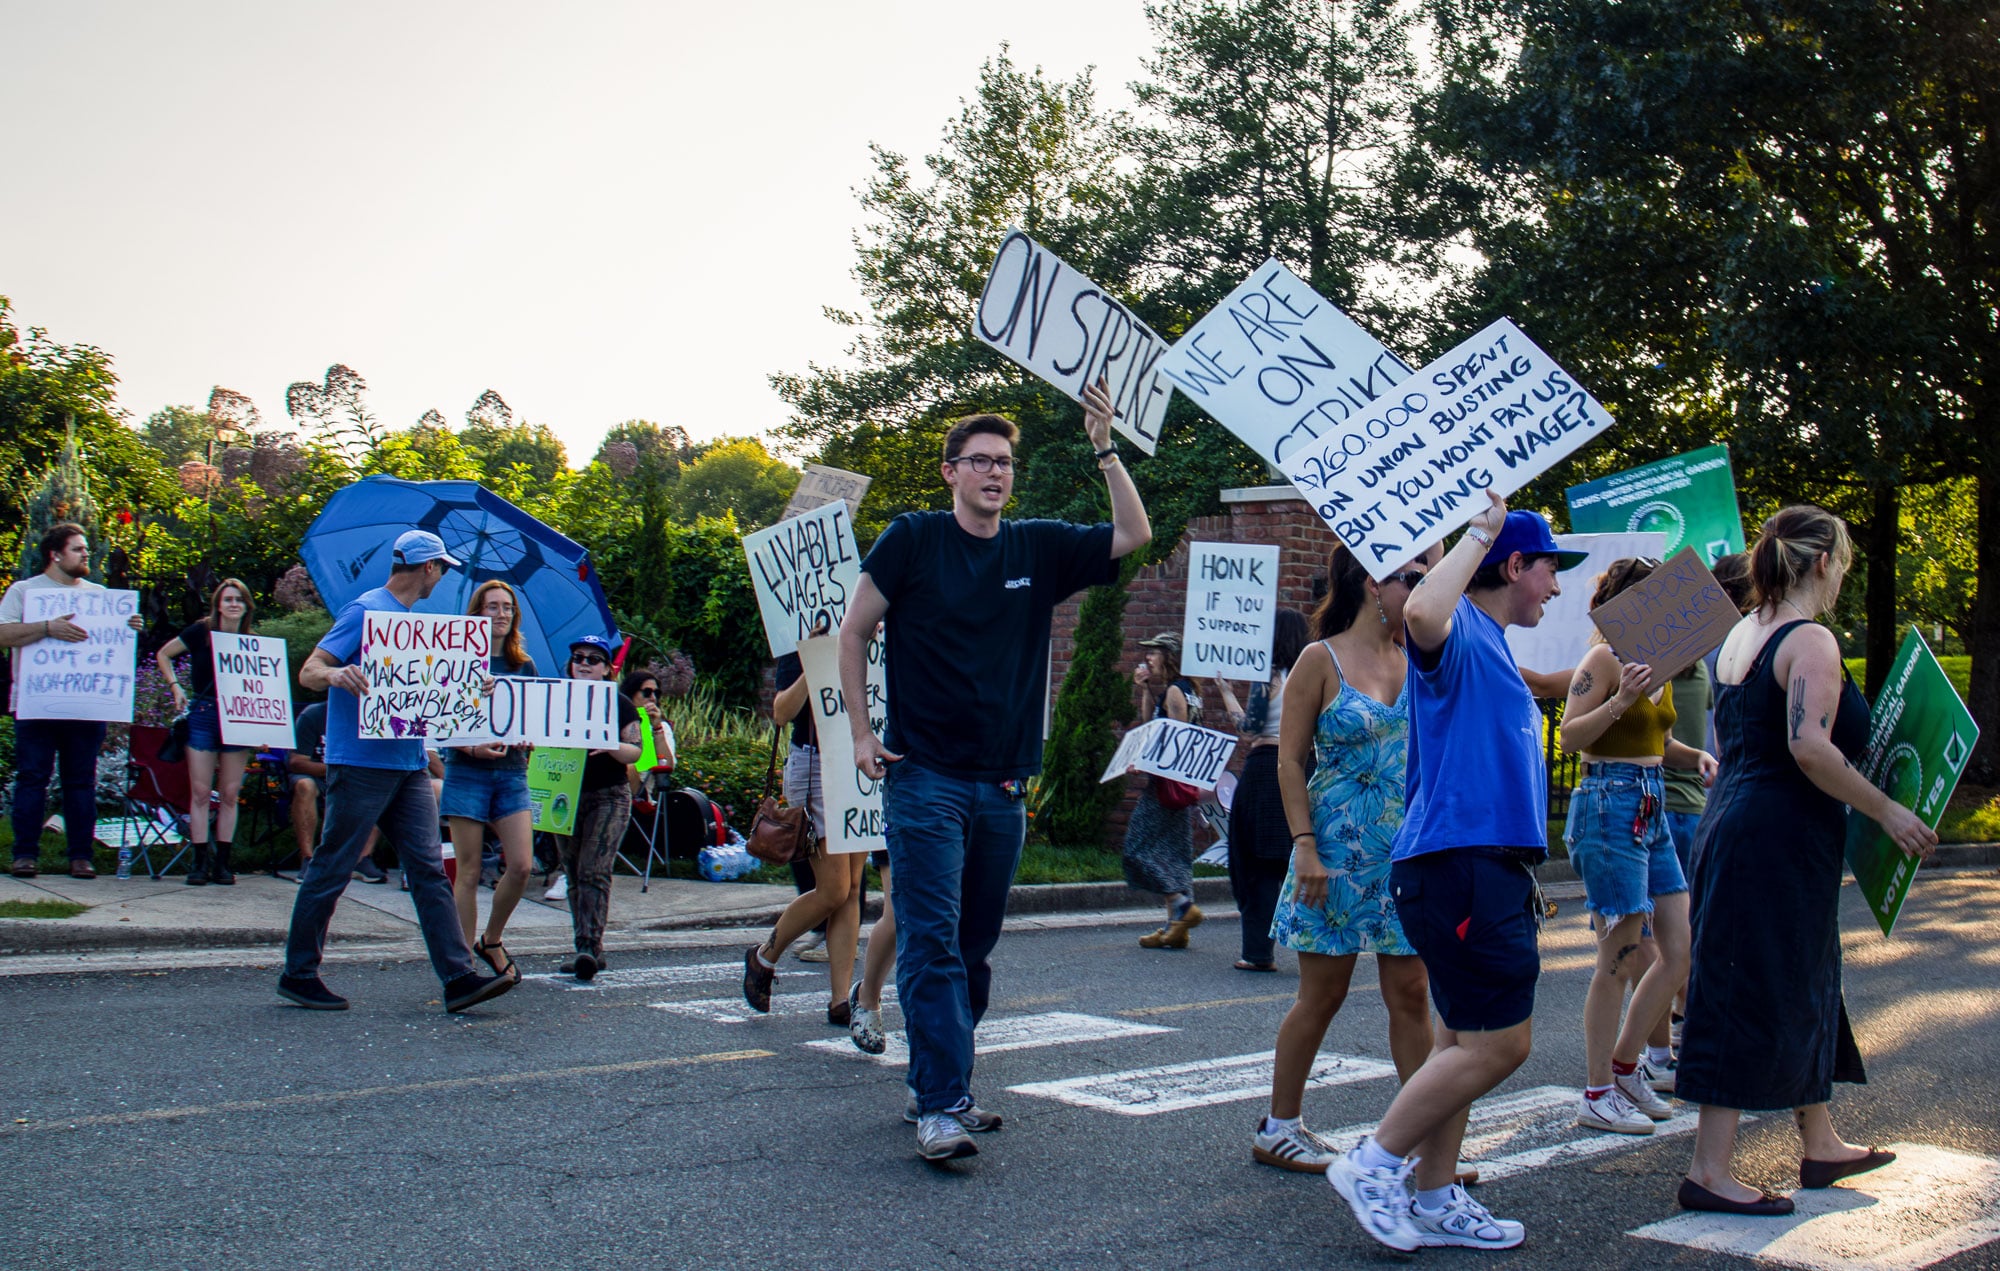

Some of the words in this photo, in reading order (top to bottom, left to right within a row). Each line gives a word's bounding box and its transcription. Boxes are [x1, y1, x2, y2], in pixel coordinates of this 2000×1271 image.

[978, 231, 1061, 361] ON
[1052, 289, 1168, 442] STRIKE
[1163, 331, 1246, 397] WE
[1228, 270, 1319, 356] ARE
[1257, 334, 1336, 406] ON
[1292, 392, 1428, 491] $260,000
[1432, 333, 1508, 396] SPENT
[1318, 490, 1354, 520] ON
[1357, 432, 1427, 489] UNION
[1429, 355, 1532, 435] BUSTING
[1335, 501, 1388, 548] BUT
[1386, 469, 1434, 506] YOU
[1428, 421, 1495, 474] WON'T
[1489, 392, 1535, 429] PAY
[1531, 370, 1571, 403] US
[1369, 542, 1402, 563] A
[1399, 467, 1494, 542] LIVING
[1494, 391, 1595, 469] WAGE?
[1571, 493, 1601, 509] LEWIS
[1684, 457, 1727, 476] GARDEN
[754, 510, 852, 592] LIVABLE
[1201, 554, 1264, 586] HONK
[33, 592, 133, 616] TAKING
[774, 566, 846, 618] WAGES
[1206, 592, 1221, 611] IF
[1235, 596, 1264, 613] YOU
[1603, 559, 1698, 639] SUPPORT
[368, 617, 489, 657] WORKERS
[798, 601, 847, 641] NOW
[1197, 617, 1260, 635] SUPPORT
[1623, 584, 1724, 665] WORKERS
[33, 648, 80, 668] OUT
[218, 652, 281, 677] MONEY
[239, 637, 260, 652] NO
[1195, 642, 1266, 671] UNIONS
[26, 672, 131, 698] NON-PROFIT
[243, 679, 264, 694] NO
[363, 659, 420, 688] MAKE
[433, 659, 485, 684] OUR
[1895, 642, 1923, 696] GARDEN
[221, 694, 287, 720] WORKERS!
[363, 690, 426, 730] GARDEN
[1875, 684, 1893, 715] WITH
[1880, 698, 1907, 747] UNITED!
[536, 752, 580, 773] Thrive
[1157, 727, 1237, 783] STRIKE
[547, 772, 562, 782] TOO
[1879, 858, 1908, 916] VOTE
[1921, 774, 1946, 817] YES
